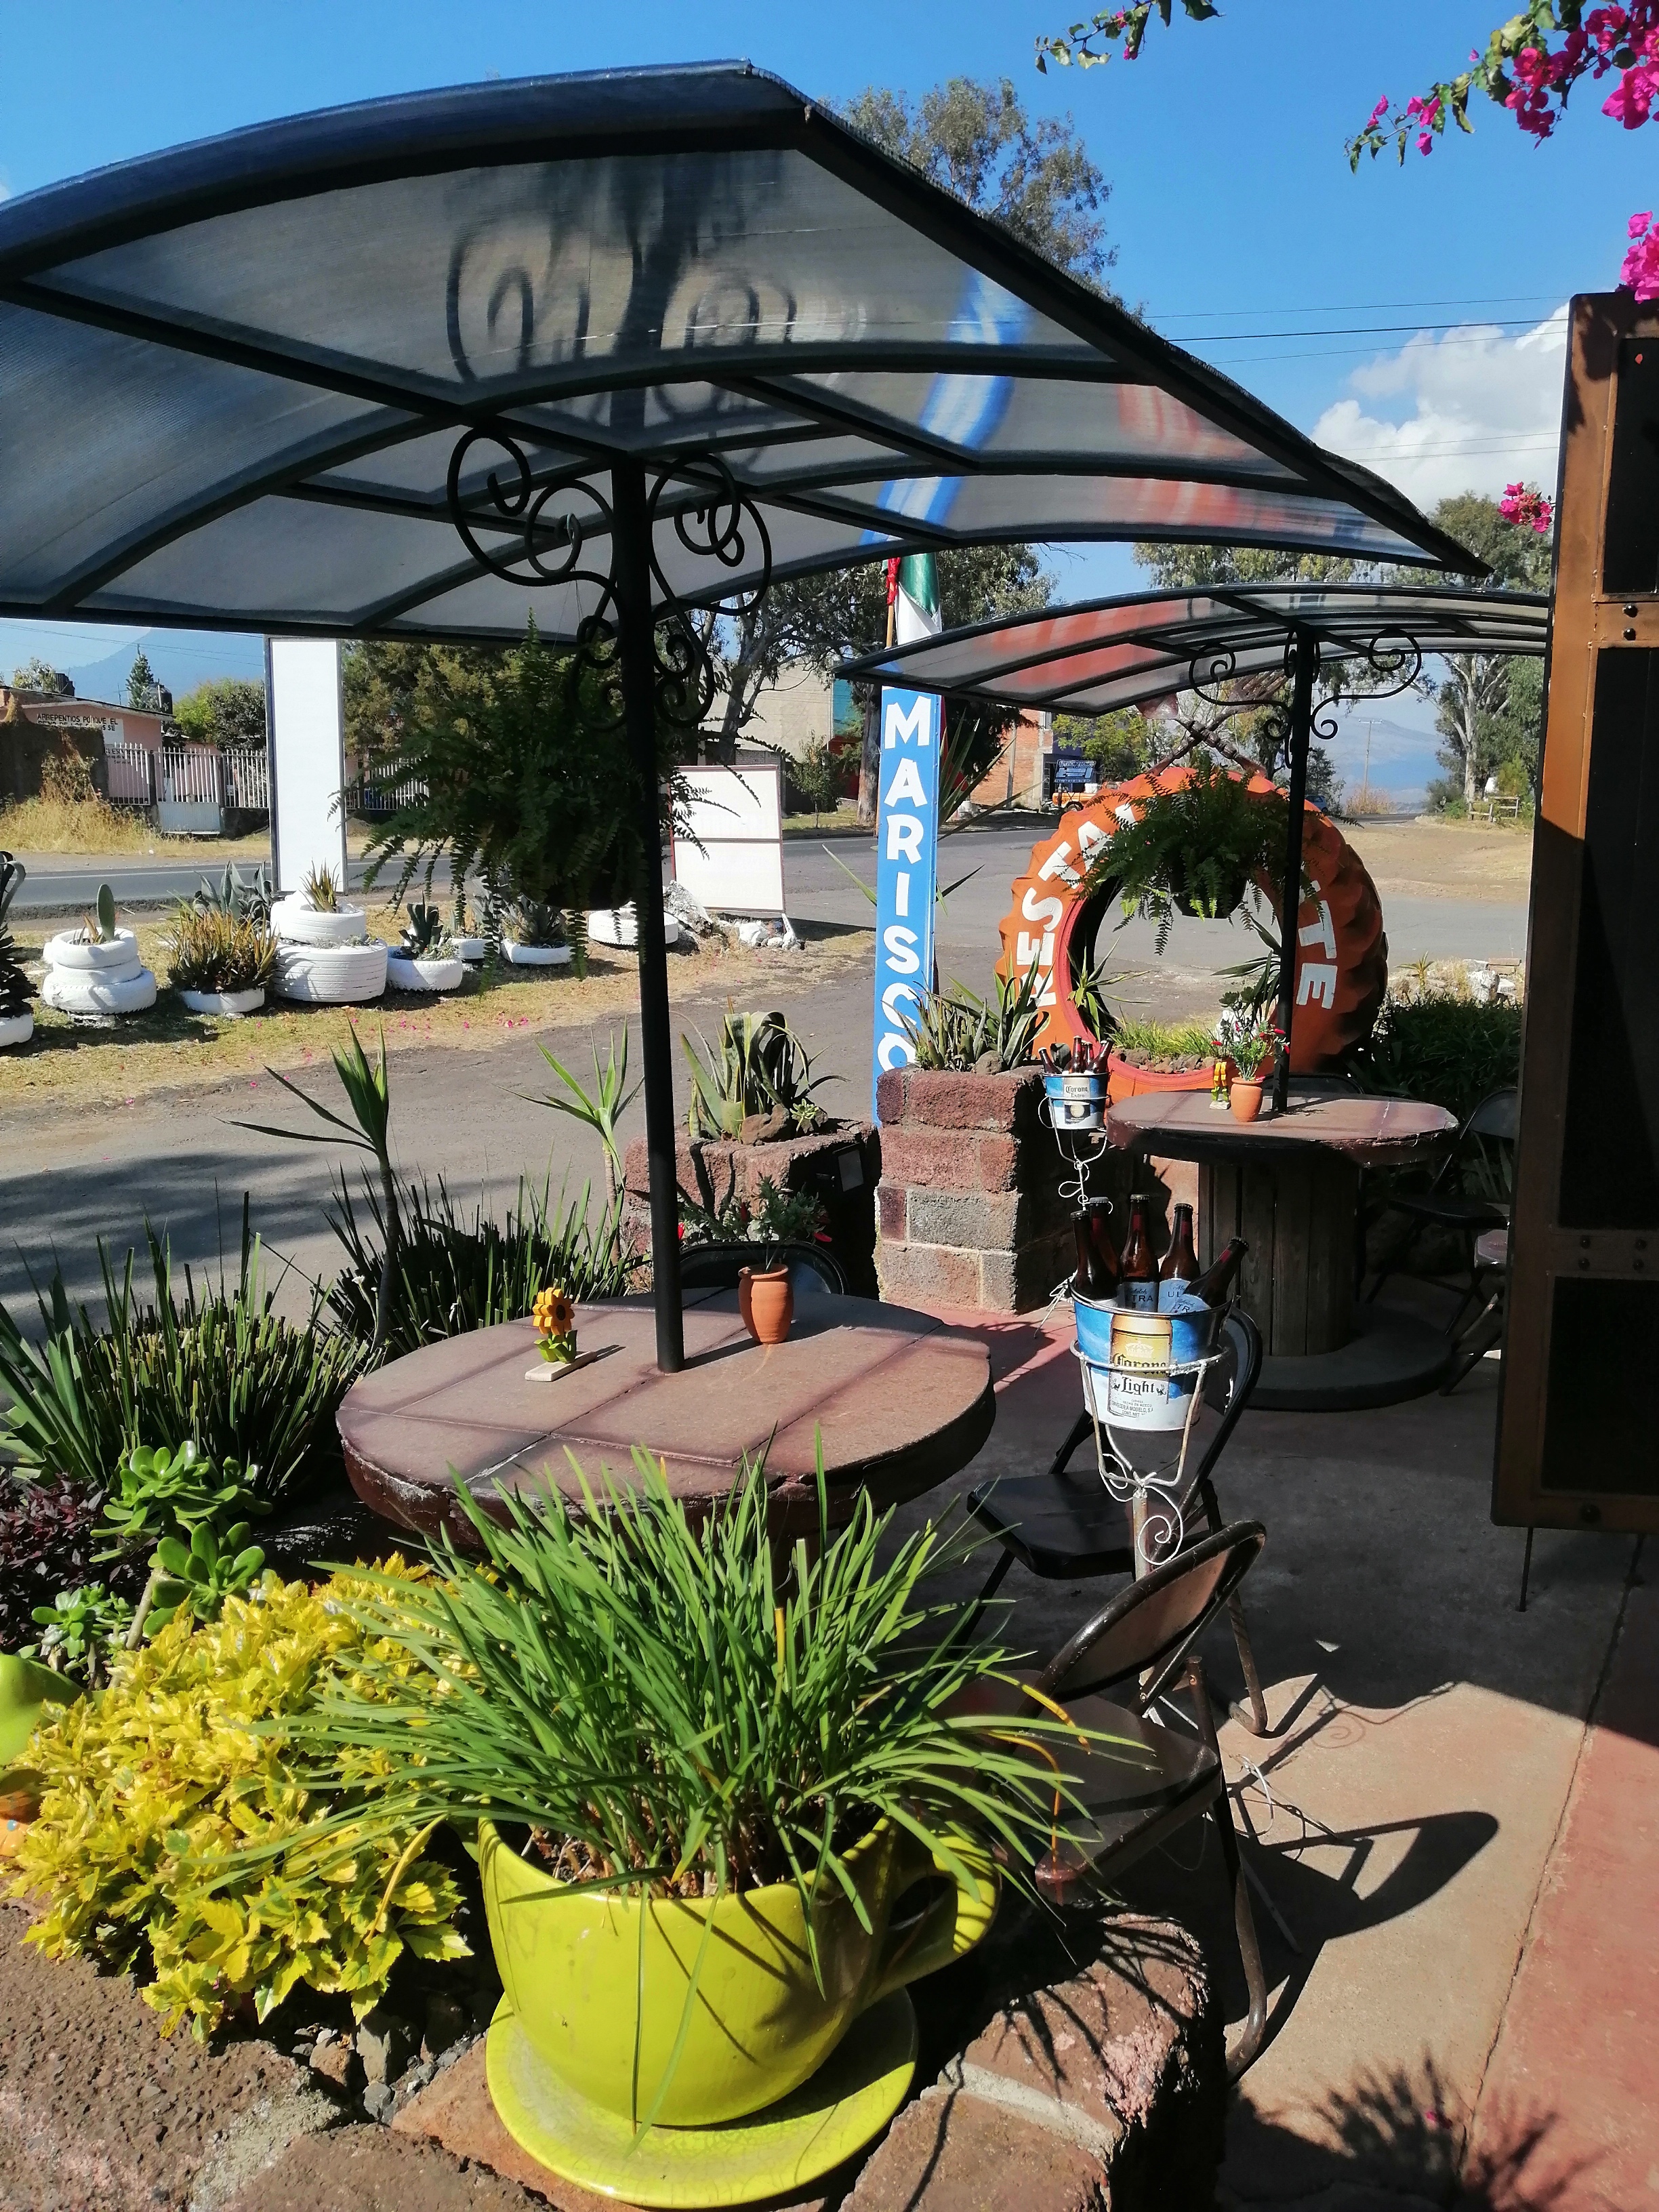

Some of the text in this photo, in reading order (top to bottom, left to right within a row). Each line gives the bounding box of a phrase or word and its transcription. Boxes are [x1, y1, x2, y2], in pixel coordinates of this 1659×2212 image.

[1065, 1085, 1089, 1094] Corona
[1125, 1294, 1154, 1303] LTRA
[1121, 1376, 1155, 1396] Light
